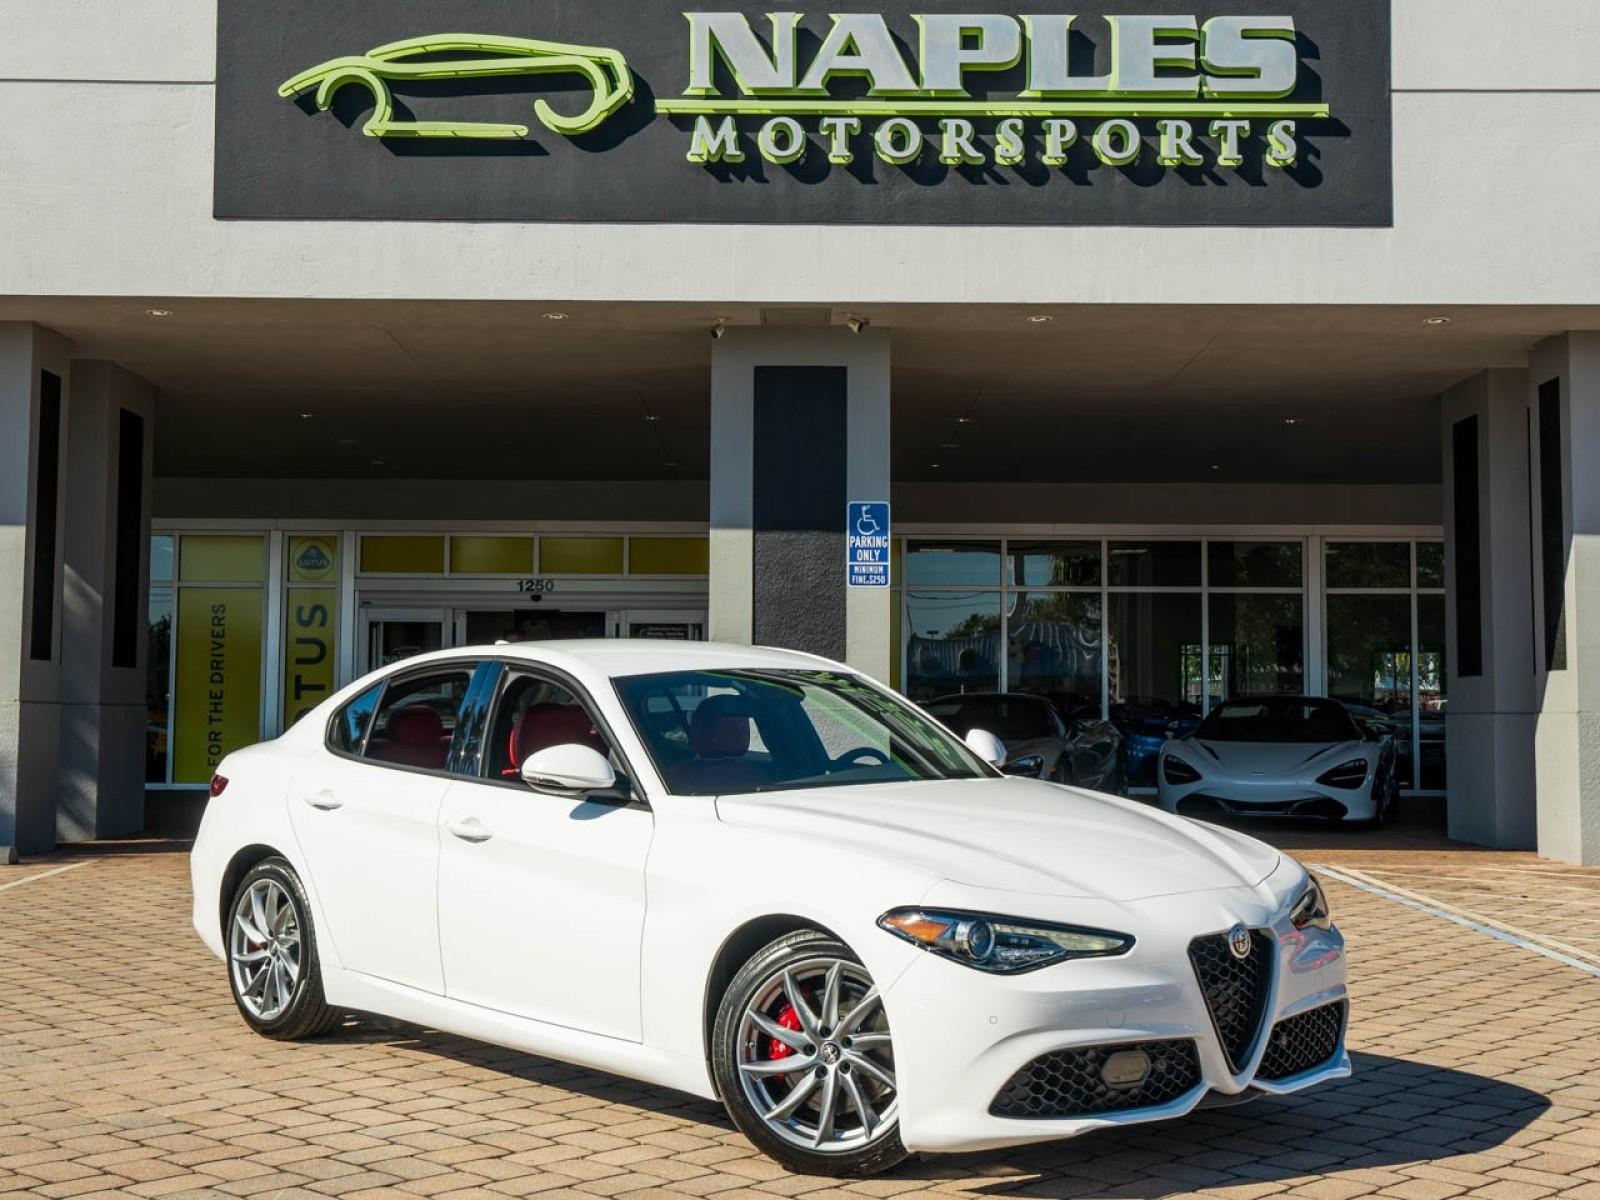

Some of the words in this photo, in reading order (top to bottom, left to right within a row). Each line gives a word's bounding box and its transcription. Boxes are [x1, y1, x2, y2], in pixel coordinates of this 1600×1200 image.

[682, 12, 1297, 99] NAPLES
[686, 115, 1297, 166] MOTORSPORTS
[849, 536, 887, 548] PARKING
[856, 549, 880, 561] ONLY
[517, 579, 554, 592] 1250
[854, 565, 884, 574] MINIMUM
[209, 603, 227, 684] DRIVERS
[293, 603, 328, 724] TUS
[208, 690, 225, 725] THE
[207, 730, 223, 767] FOR
